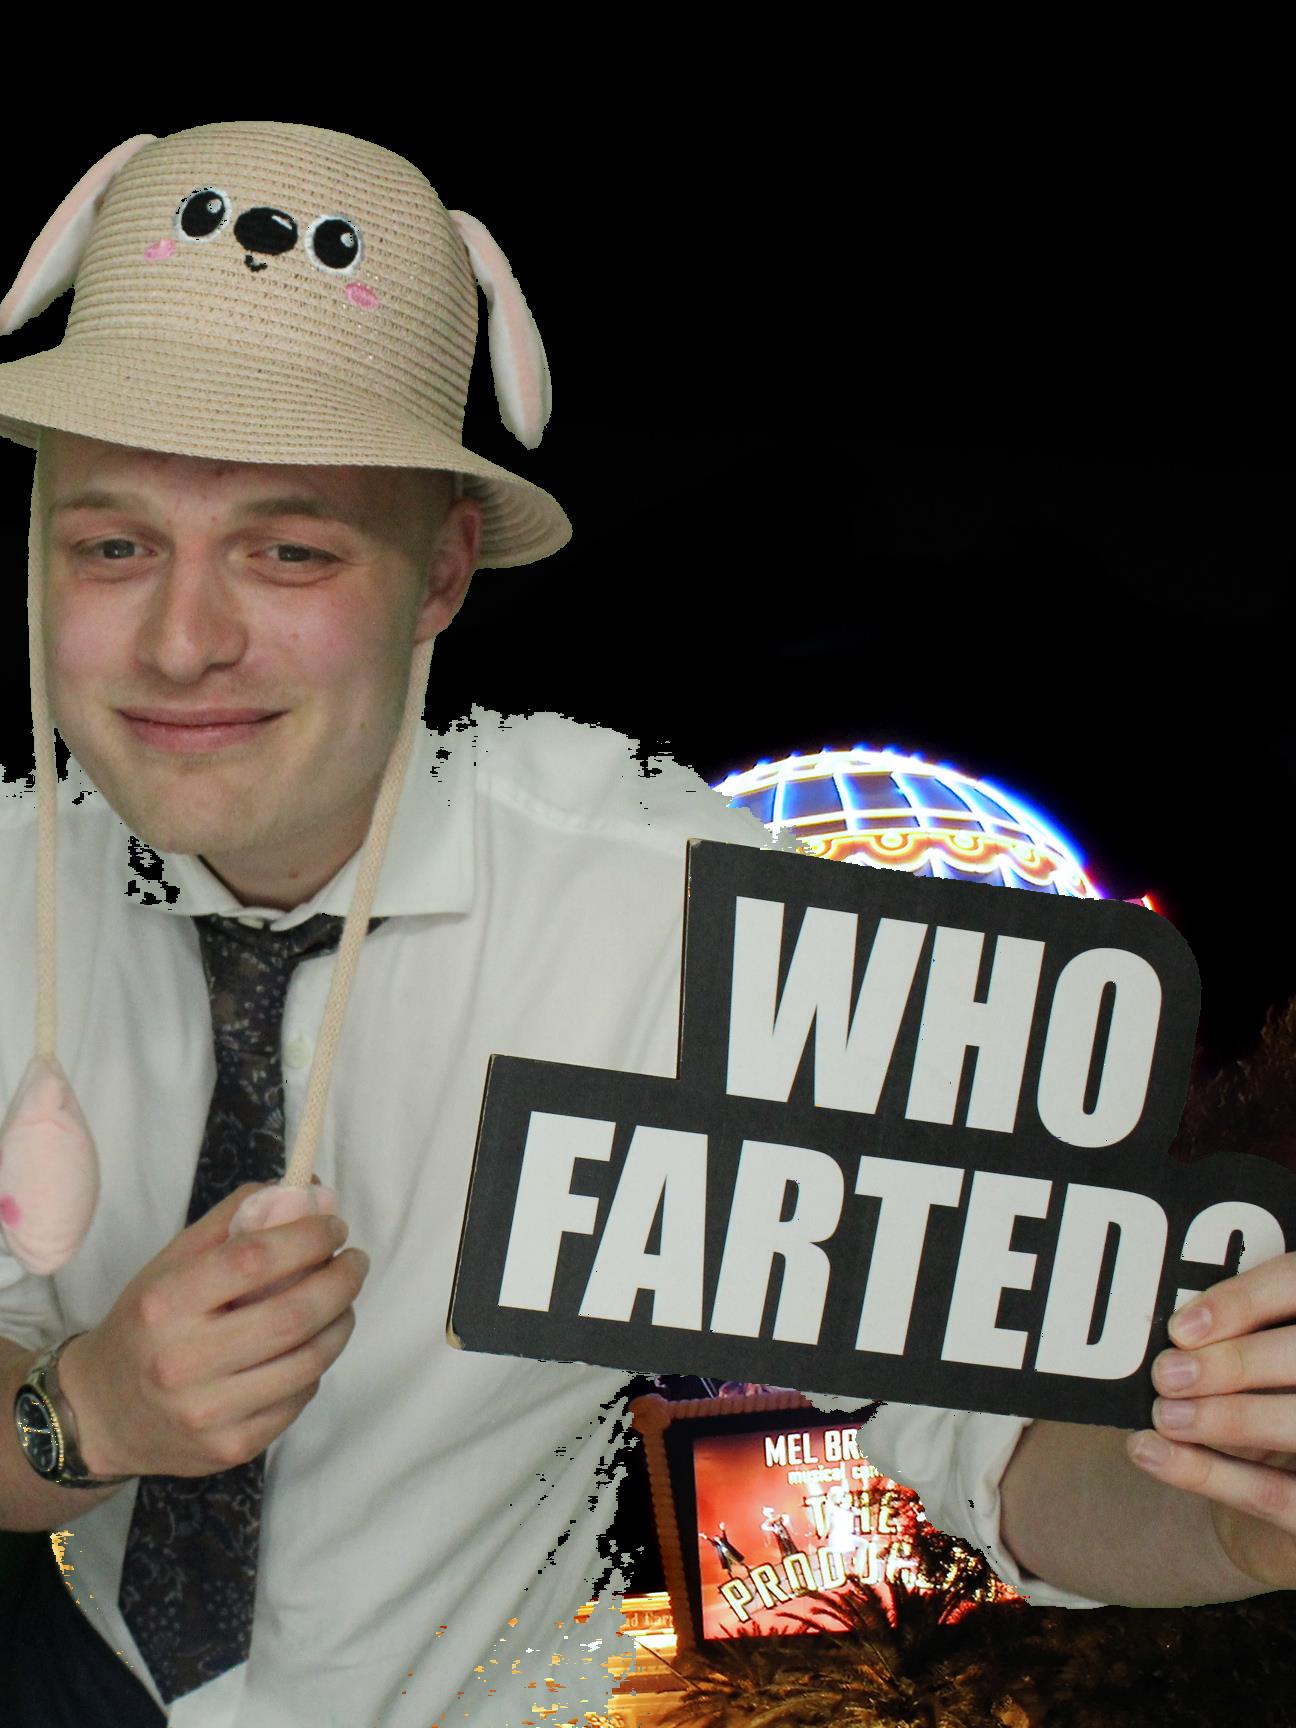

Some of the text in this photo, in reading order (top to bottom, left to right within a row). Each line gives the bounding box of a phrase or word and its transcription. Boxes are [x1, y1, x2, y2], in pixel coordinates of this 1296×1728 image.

[726, 896, 1162, 1149] WHO
[764, 1428, 869, 1468] MEL BR
[804, 1490, 900, 1538] THE
